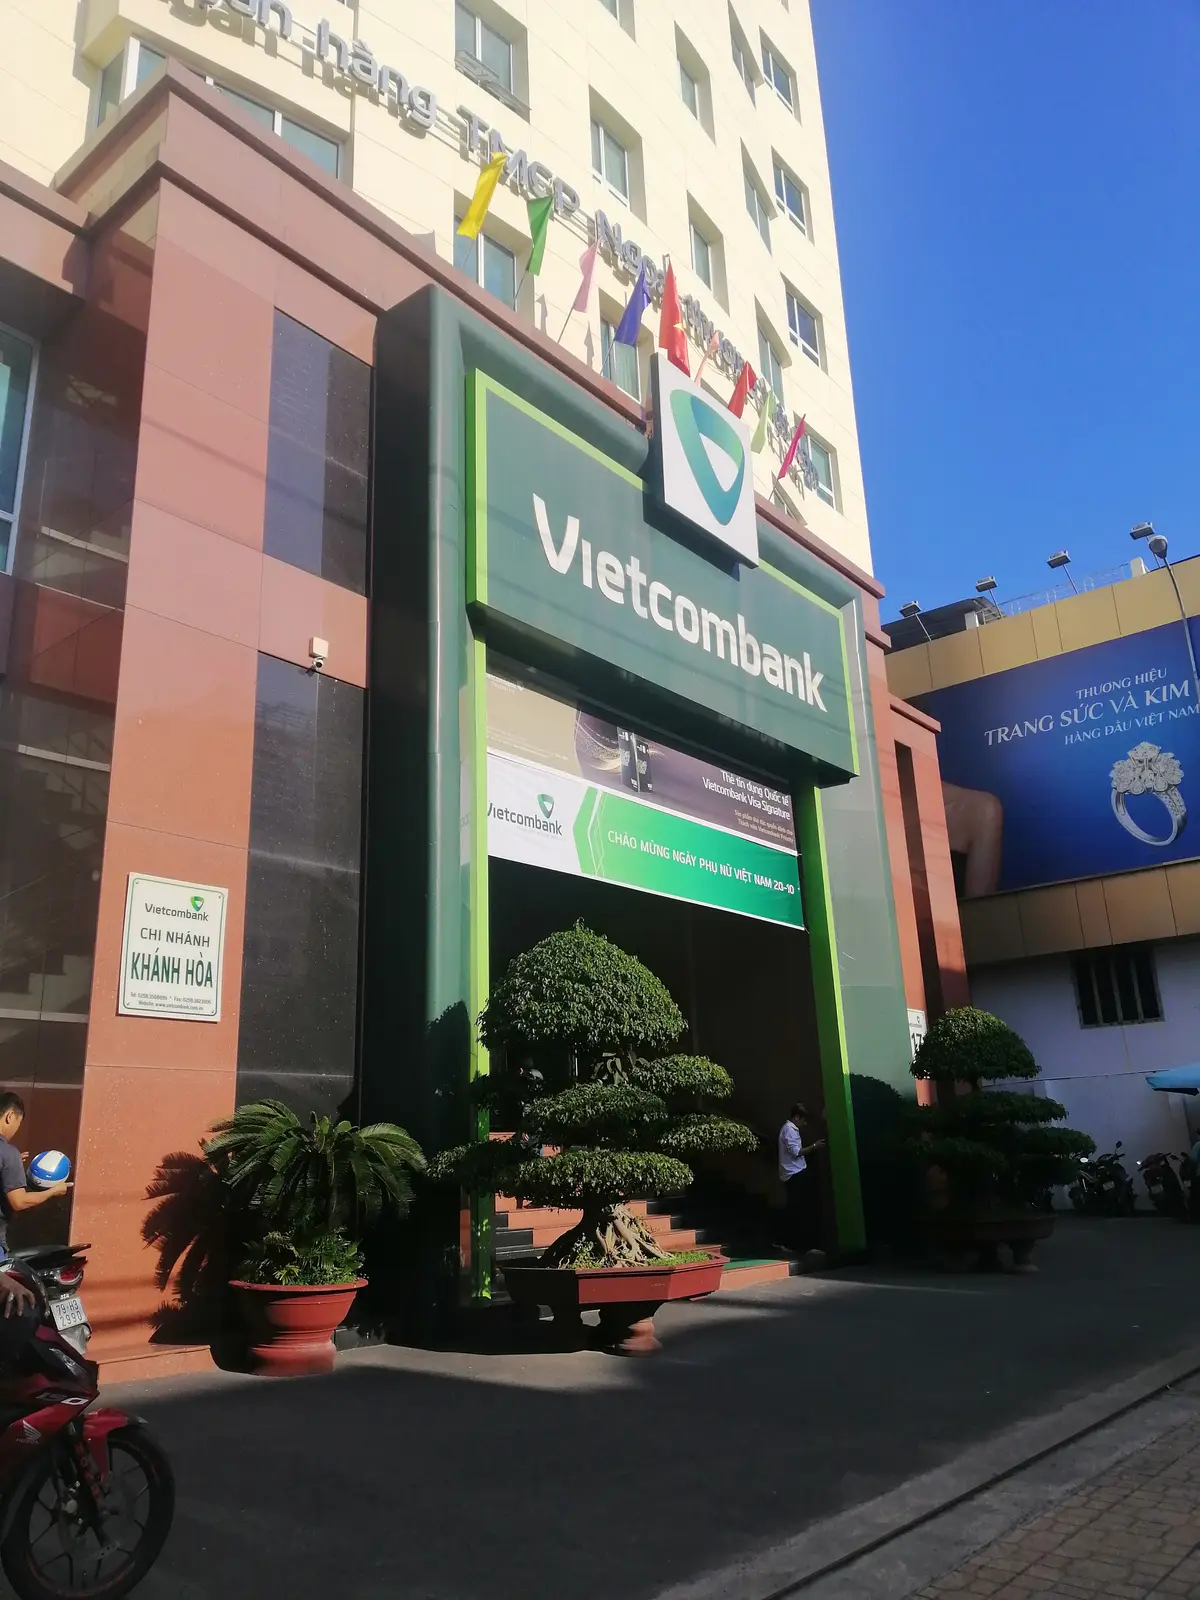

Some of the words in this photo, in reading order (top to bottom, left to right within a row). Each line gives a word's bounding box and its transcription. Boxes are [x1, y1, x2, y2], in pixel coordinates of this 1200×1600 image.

[317, 18, 436, 130] hàng
[533, 493, 828, 713] Vietcombank
[1135, 667, 1167, 684] HIỆU
[984, 715, 1054, 745] TRANG
[1060, 702, 1104, 727] SỨC
[1109, 690, 1139, 714] VÀ
[1145, 679, 1190, 706] KIM
[1065, 727, 1101, 745] HÀNG
[1135, 711, 1165, 728] VIỆT
[1168, 703, 1200, 720] NAM
[702, 776, 748, 804] Vietcombank
[747, 794, 761, 809] Visa
[761, 800, 791, 820] Signature
[736, 776, 746, 789] tín
[746, 781, 763, 798] dụng
[608, 830, 637, 849] CHÀO
[672, 849, 697, 867] NGÀY
[699, 857, 718, 875] PHỤ
[734, 867, 752, 883] VIỆT
[754, 873, 772, 889] NAM
[773, 880, 794, 895] 20-10
[145, 903, 209, 921] Vietcombank
[140, 927, 161, 941] CHI
[166, 930, 210, 947] NHÁNH
[131, 947, 181, 984] KHÁNH
[185, 951, 213, 988] HÒA
